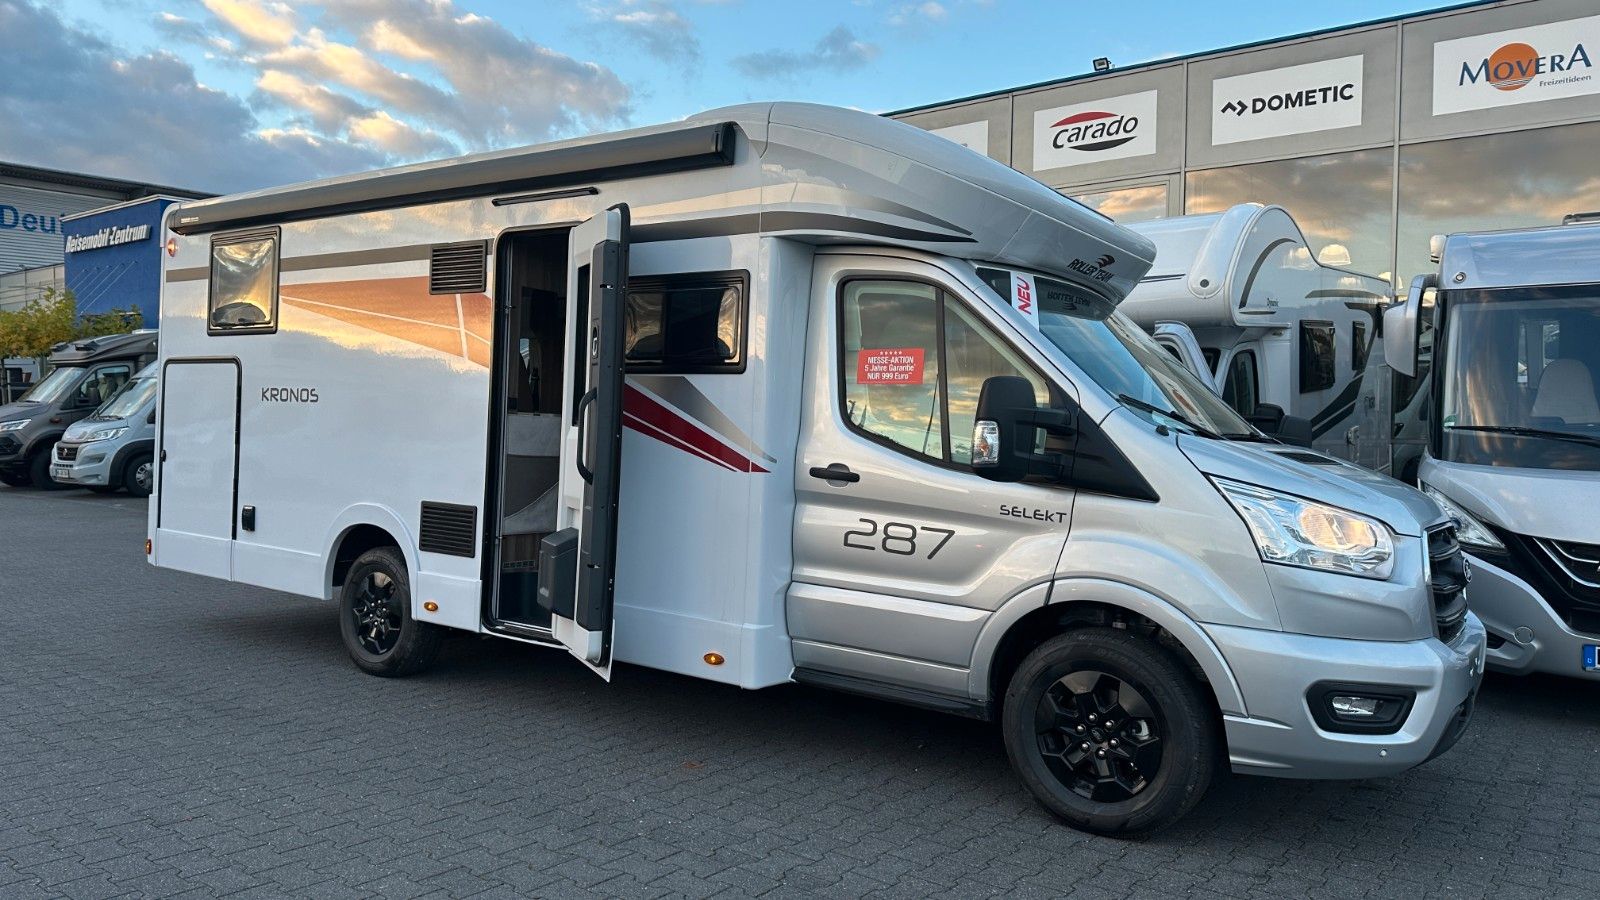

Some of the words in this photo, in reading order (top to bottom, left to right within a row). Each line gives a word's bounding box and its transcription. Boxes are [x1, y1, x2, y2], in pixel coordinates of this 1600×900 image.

[1539, 75, 1592, 87] Freizeitideen
[1251, 83, 1354, 115] DOMETIC
[1067, 258, 1098, 276] ROLLER
[1093, 268, 1115, 284] TEAM
[1017, 276, 1032, 316] NEU
[867, 356, 914, 364] MESSE-AKTION
[261, 387, 319, 403] KRONOS
[999, 504, 1067, 523] SELEKT
[843, 517, 956, 560] 287
